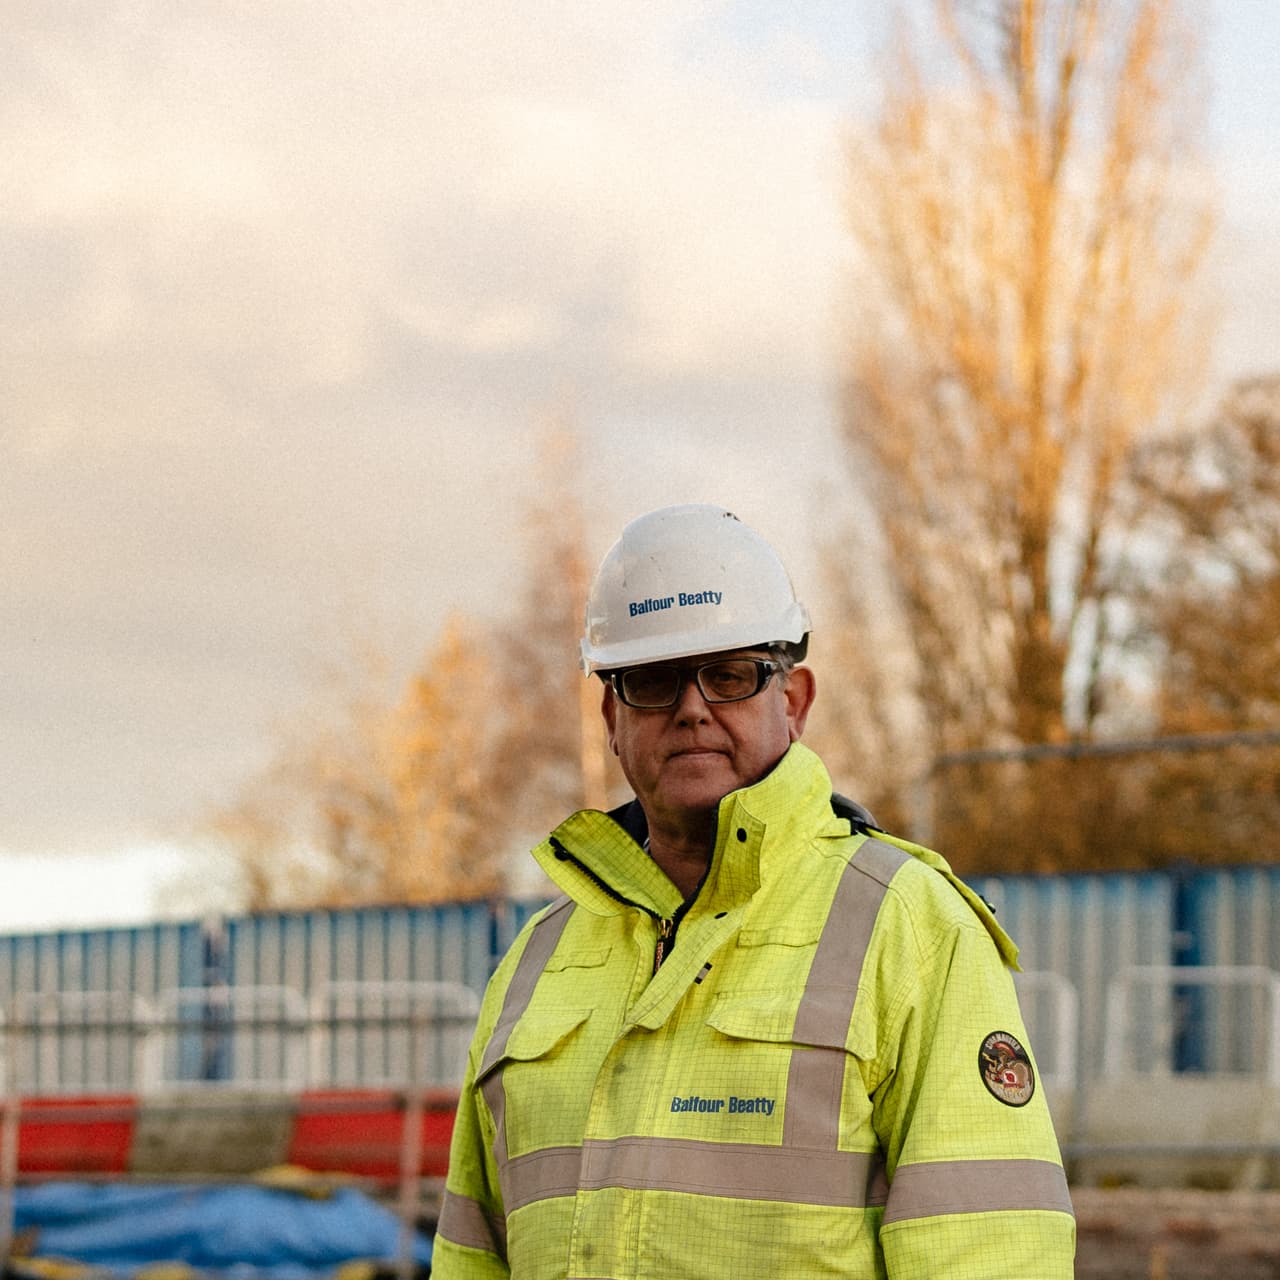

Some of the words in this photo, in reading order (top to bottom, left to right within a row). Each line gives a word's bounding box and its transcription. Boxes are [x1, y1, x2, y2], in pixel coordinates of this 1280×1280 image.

[629, 596, 675, 617] Balfour
[678, 590, 722, 606] Beatty
[670, 1096, 725, 1113] Balfour
[728, 1096, 776, 1116] Beatty
